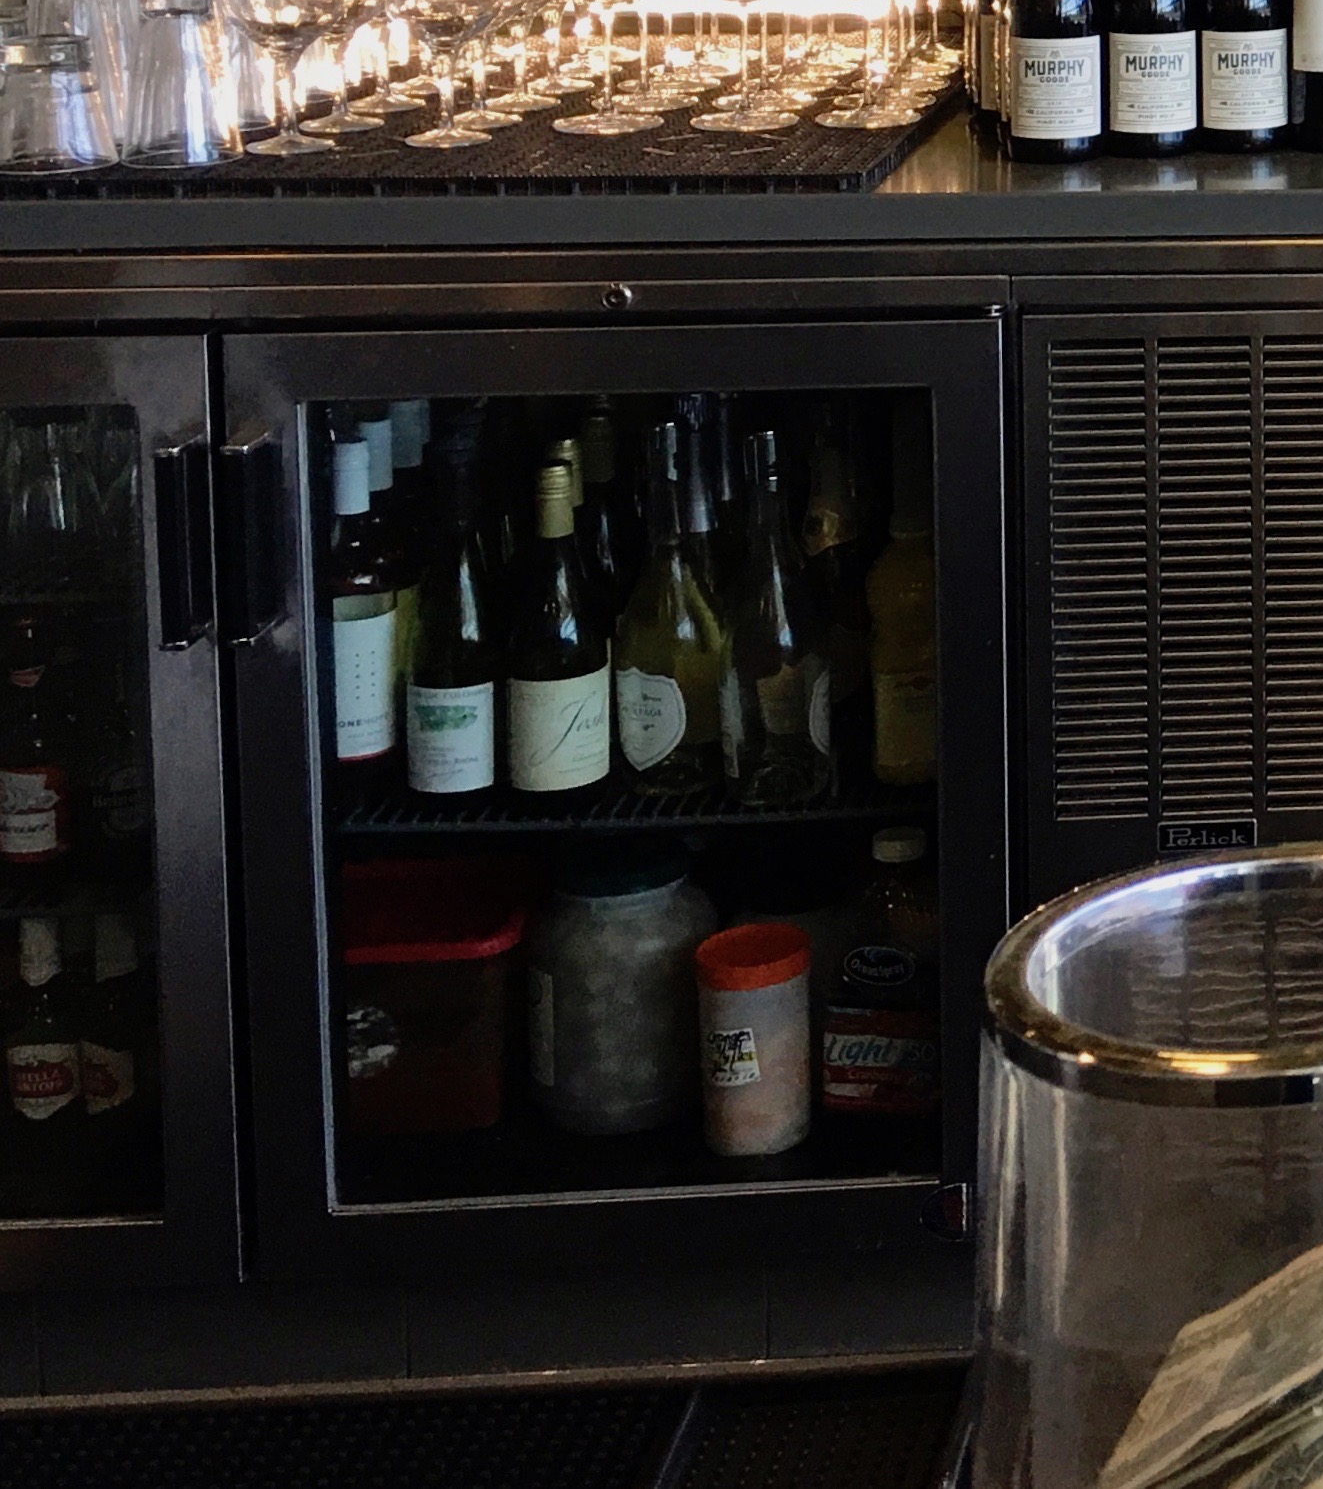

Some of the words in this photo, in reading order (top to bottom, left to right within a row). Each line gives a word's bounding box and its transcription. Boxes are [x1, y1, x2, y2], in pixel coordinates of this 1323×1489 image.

[1024, 59, 1085, 78] MURPHY
[1125, 54, 1184, 73] MURPHY
[1217, 51, 1276, 71] MURPHY
[1039, 75, 1070, 84] GOODE
[1141, 70, 1170, 79] GOODE
[1233, 67, 1262, 76] GOODE
[1165, 826, 1248, 848] Perlick
[825, 1034, 894, 1066] Light
